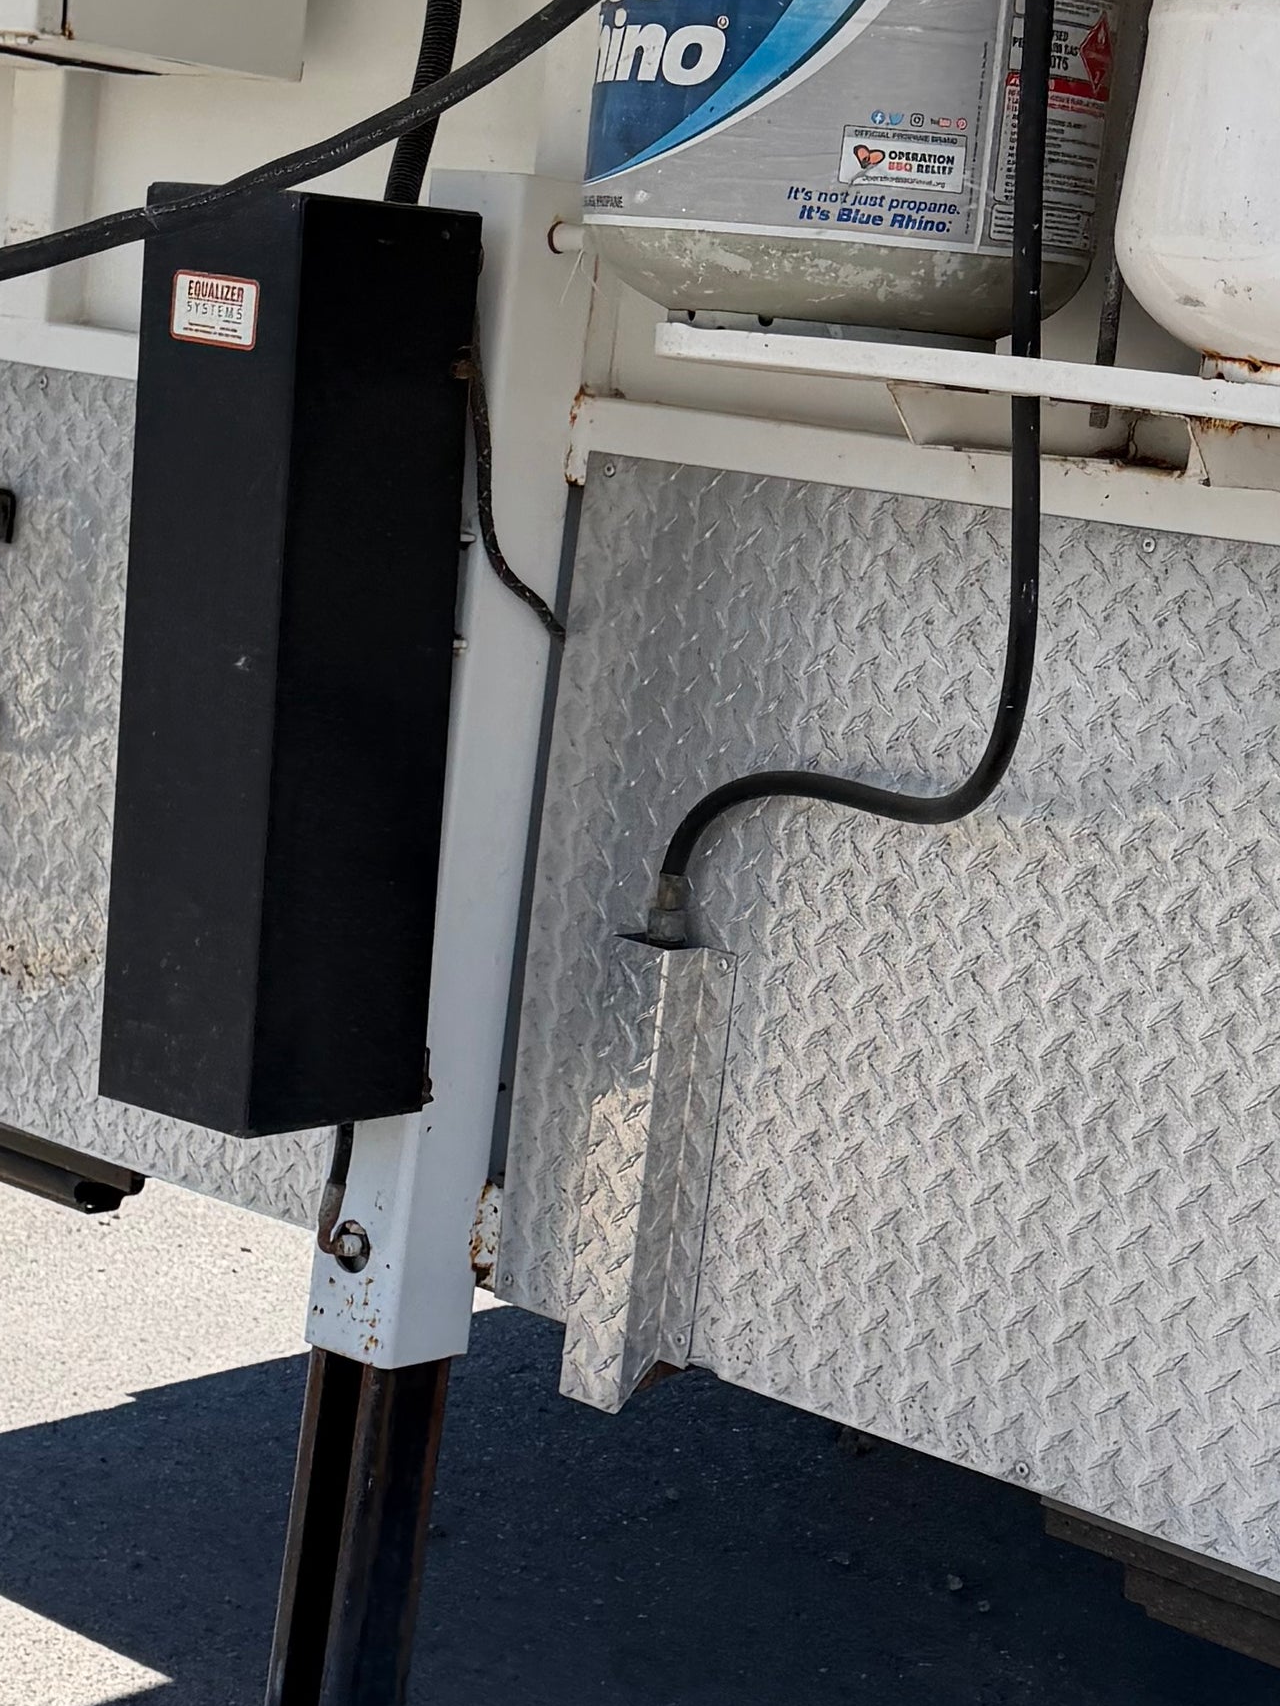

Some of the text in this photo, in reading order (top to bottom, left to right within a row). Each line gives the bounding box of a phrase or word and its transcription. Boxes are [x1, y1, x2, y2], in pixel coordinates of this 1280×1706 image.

[888, 150, 955, 166] OPERATION
[916, 163, 954, 176] RELIEF
[787, 186, 961, 215] It's not just propane.
[799, 204, 830, 221] It's
[836, 207, 884, 226] Blue
[187, 279, 245, 303] EQUALIZER
[186, 301, 243, 320] SYSTEMS
